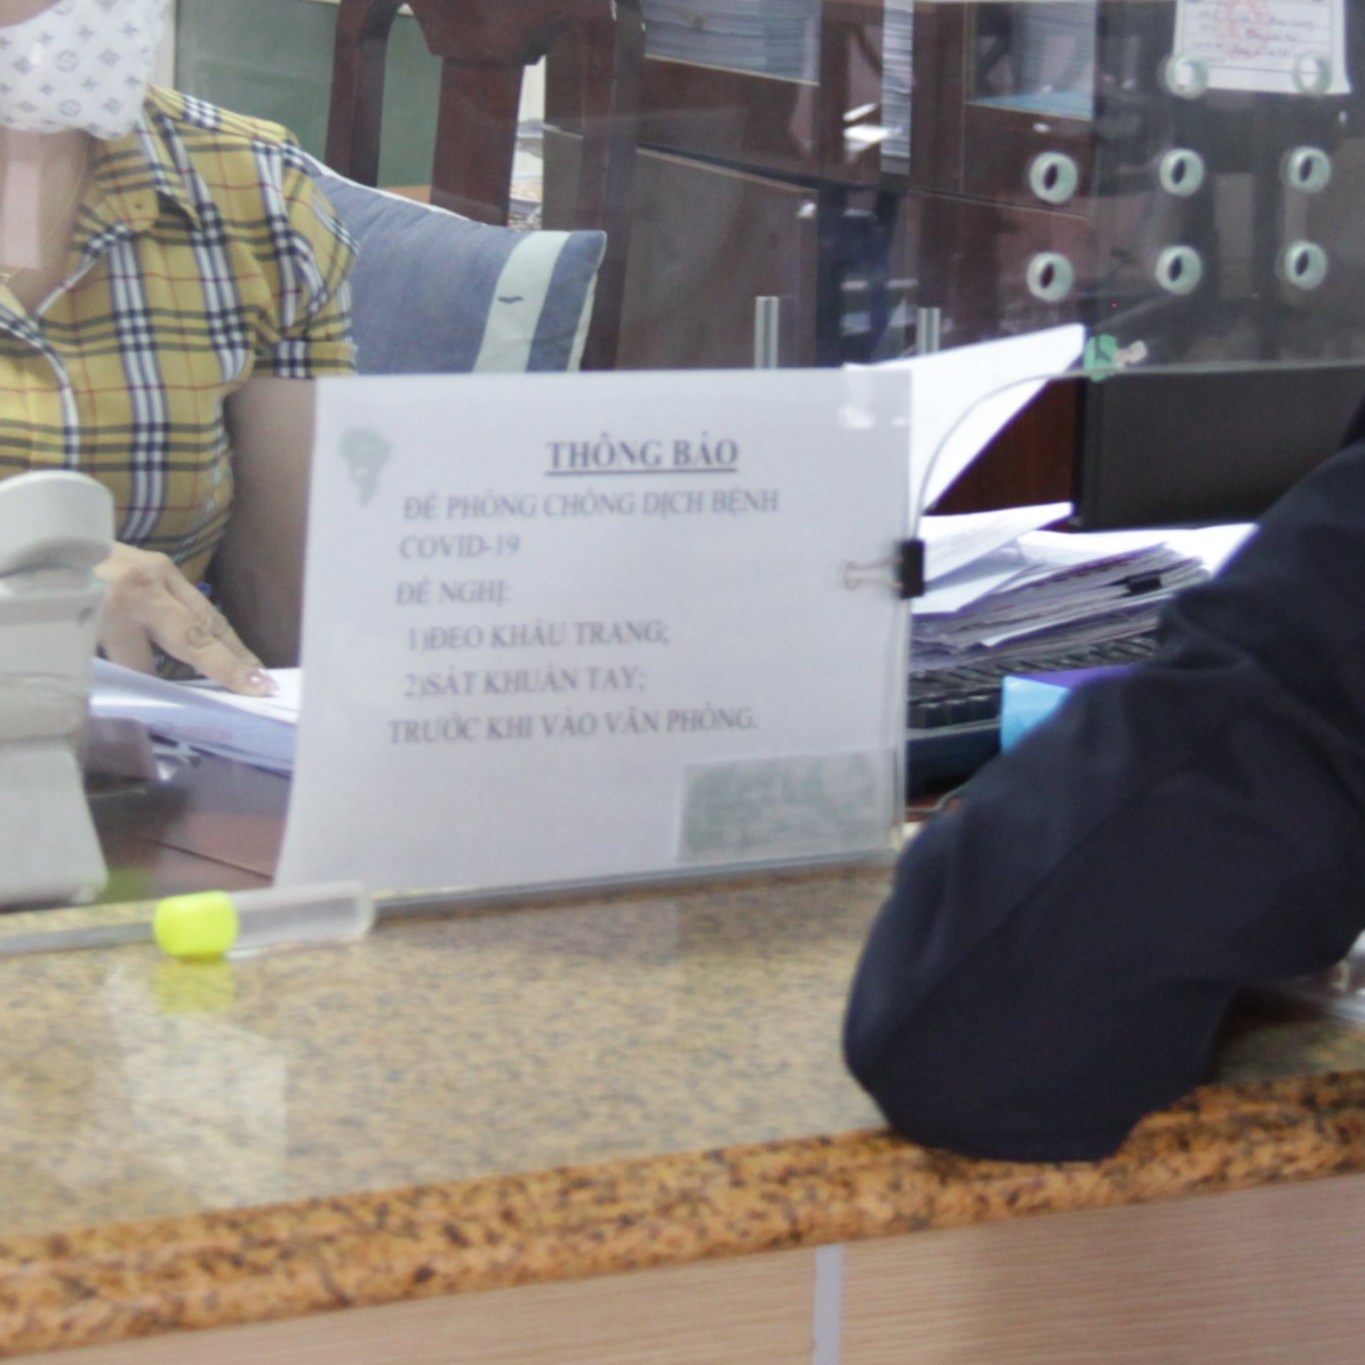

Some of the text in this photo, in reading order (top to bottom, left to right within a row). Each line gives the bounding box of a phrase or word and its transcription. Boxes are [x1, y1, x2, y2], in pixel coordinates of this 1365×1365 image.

[546, 430, 740, 470] THÔNG BÁO
[542, 486, 636, 518] CHỐNG
[641, 490, 704, 520] DỊCH
[710, 487, 779, 518] BỆNH
[399, 532, 521, 560] COVID-19
[388, 709, 481, 745] TRƯỚC
[485, 714, 533, 742] KHI
[539, 707, 599, 739] VÀO
[603, 705, 659, 735] VĂN
